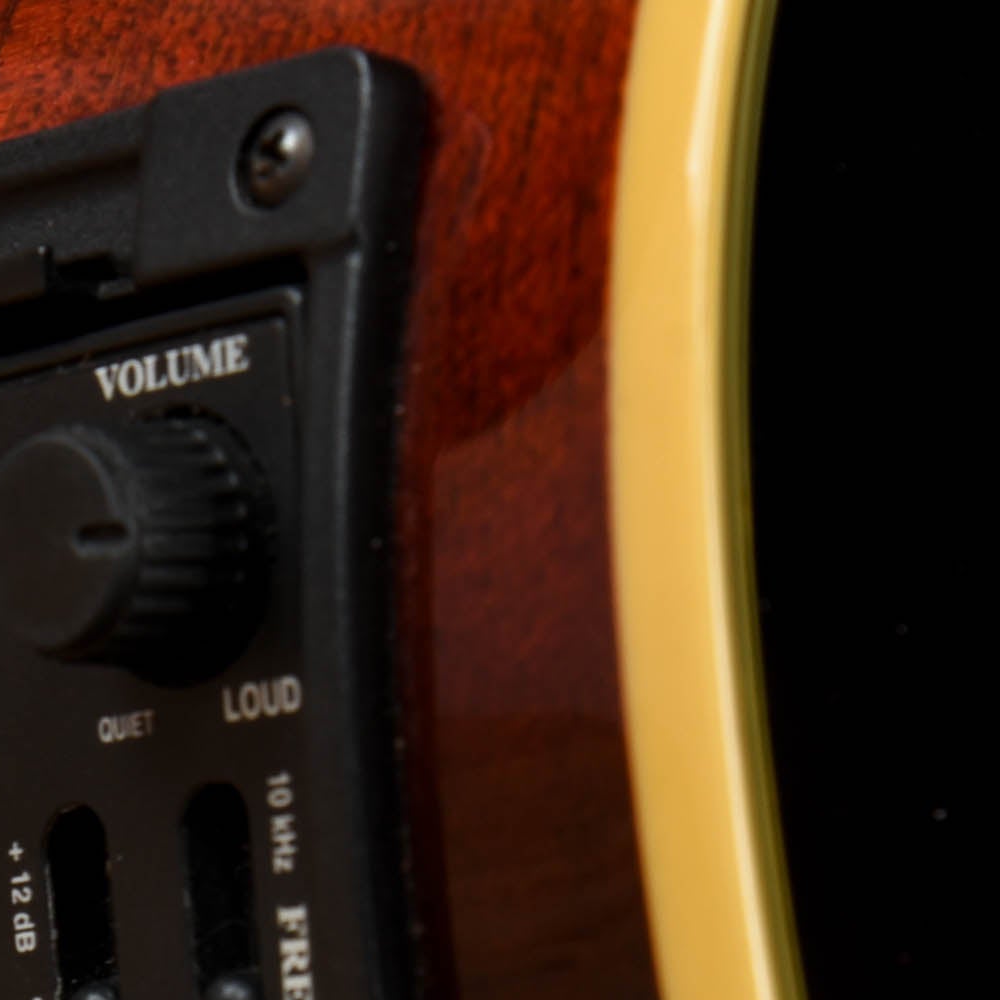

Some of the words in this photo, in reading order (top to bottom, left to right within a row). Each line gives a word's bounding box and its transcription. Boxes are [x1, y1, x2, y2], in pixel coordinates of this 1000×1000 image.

[94, 333, 250, 401] VOLUME
[223, 676, 301, 722] LOUD
[98, 710, 154, 743] QUIET
[267, 772, 292, 808] 10
[271, 814, 296, 873] kHz
[12, 912, 37, 953] dB
